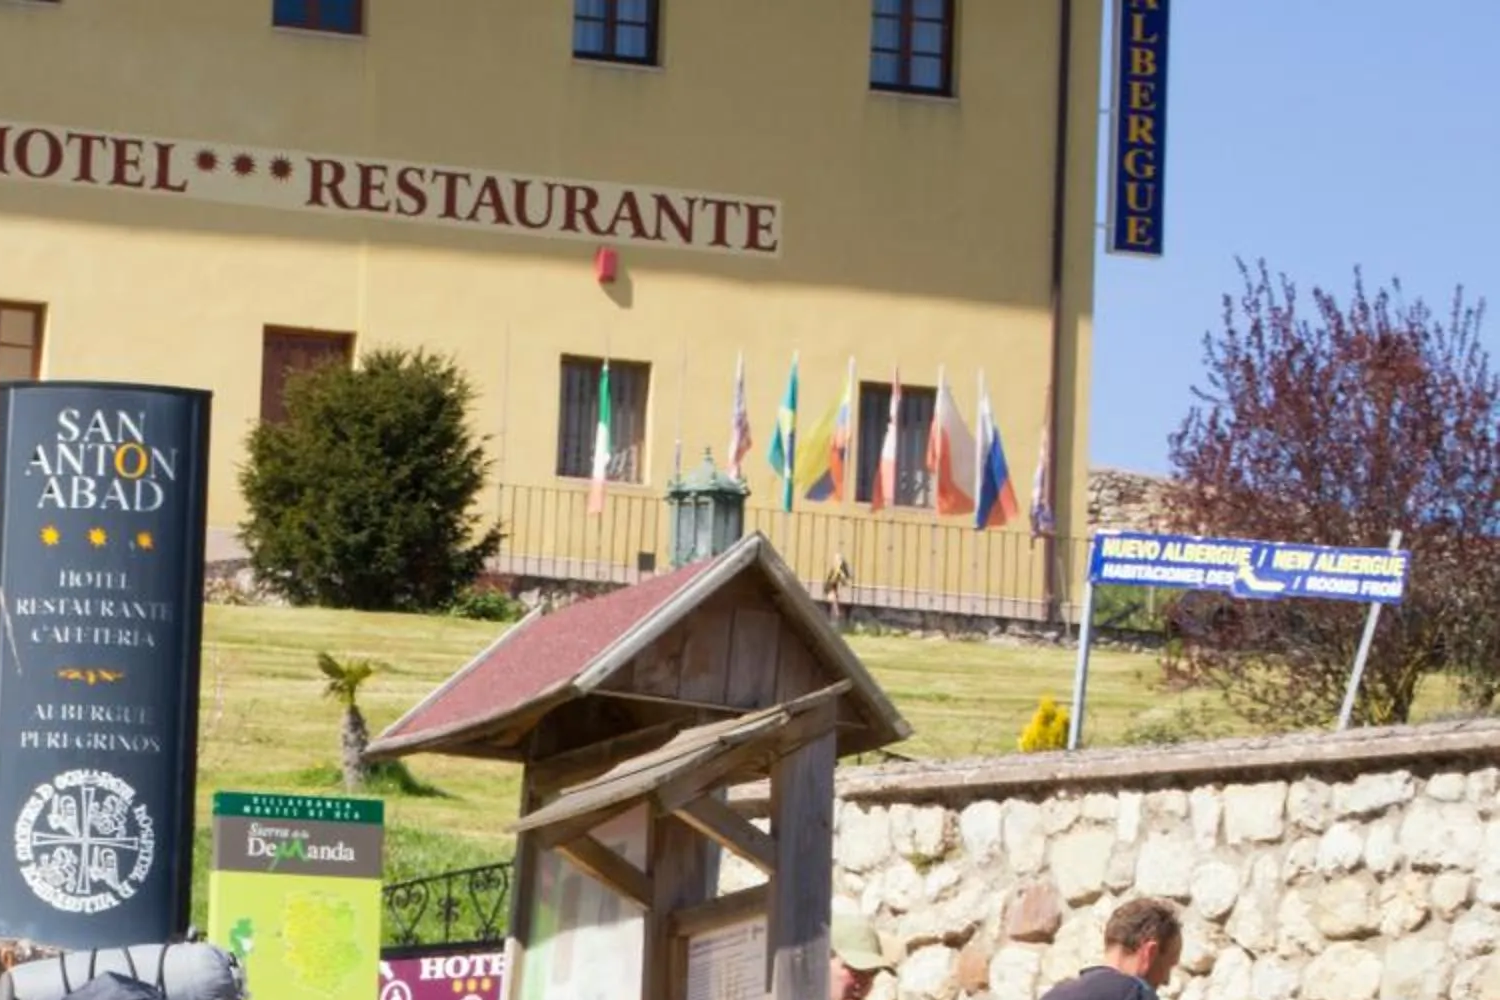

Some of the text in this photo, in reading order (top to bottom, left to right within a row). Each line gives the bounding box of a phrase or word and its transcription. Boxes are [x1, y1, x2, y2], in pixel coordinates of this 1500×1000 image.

[304, 156, 781, 254] RESTAURANTE
[57, 408, 146, 443] SAN
[24, 442, 178, 480] ANTON
[36, 476, 165, 512] ABAD
[1102, 537, 1161, 560] NUEVO
[1161, 541, 1252, 566] ALBERGUE
[1314, 553, 1406, 577] ALBERGUE
[59, 569, 130, 591] HOTEL
[16, 598, 173, 621] RESTAURANTE
[32, 703, 152, 725] ALBERGUE
[20, 731, 162, 752] PEREGRINOS
[419, 953, 505, 980] HOTE
